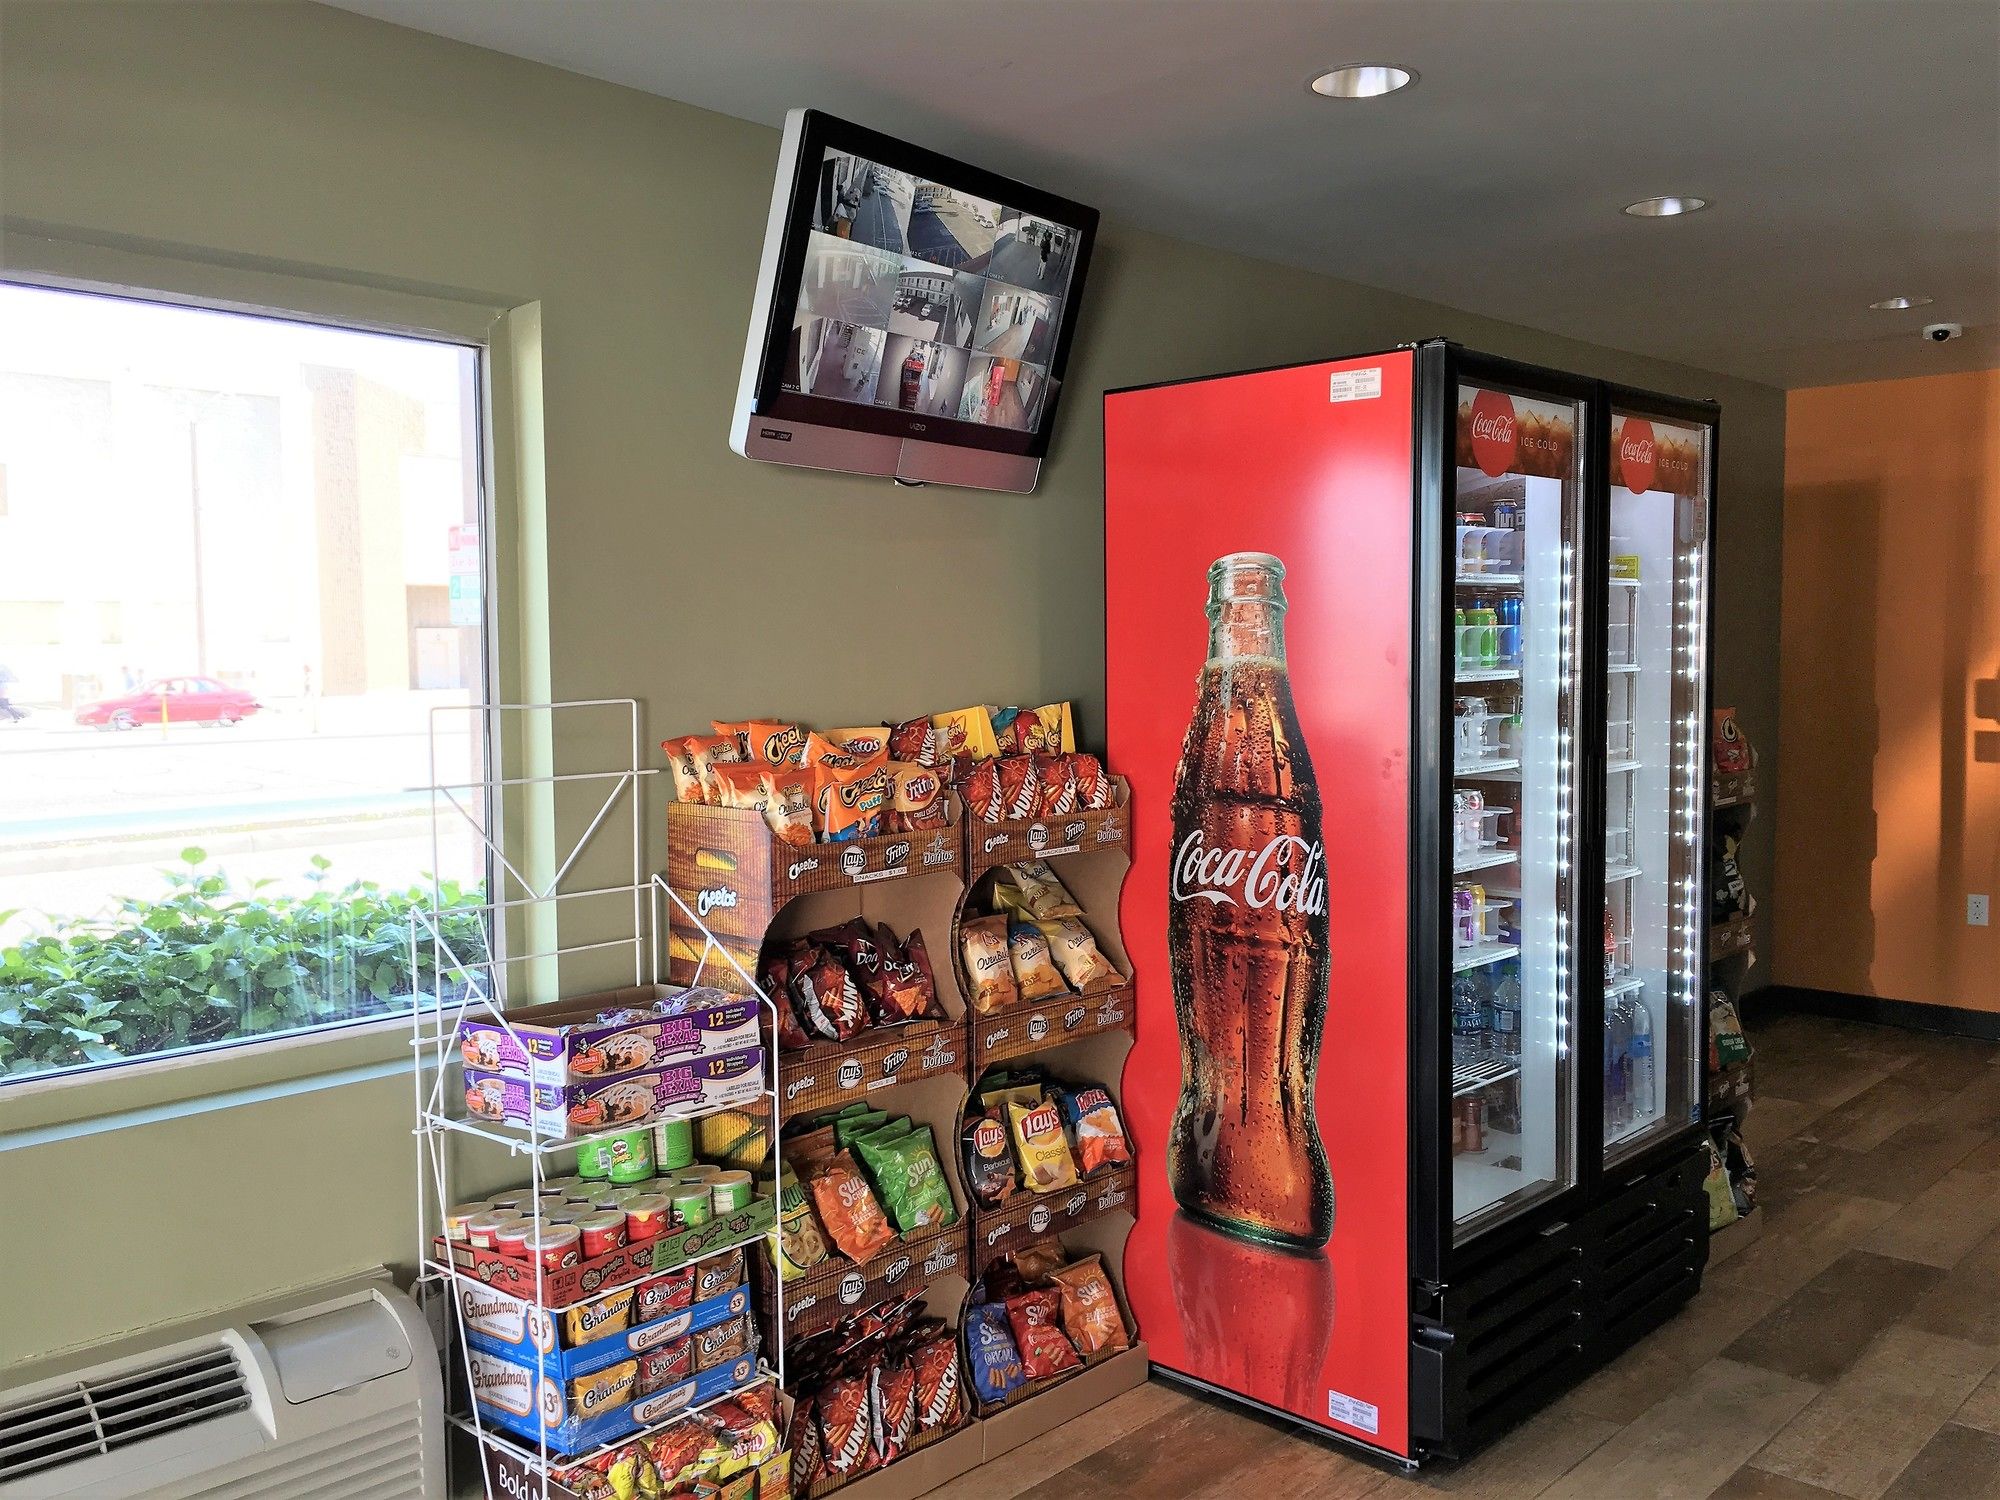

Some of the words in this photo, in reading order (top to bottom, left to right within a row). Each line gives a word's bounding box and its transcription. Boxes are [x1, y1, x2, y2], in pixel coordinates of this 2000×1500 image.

[1472, 411, 1514, 444] Coca-Cola
[1520, 436, 1534, 448] ICE
[1537, 438, 1558, 451] COLD
[1658, 458, 1670, 468] ICE
[1672, 459, 1688, 471] COLD
[905, 774, 935, 801] Fritos
[1065, 821, 1086, 841] Fritos
[1097, 828, 1122, 843] Doritos
[885, 841, 910, 864] Fritos
[923, 848, 955, 867] Doritos
[788, 856, 818, 880] Cheetos
[1173, 830, 1326, 916] Coca-Cola
[697, 885, 737, 917] Cheetos
[661, 1018, 693, 1036] BIG
[708, 1012, 724, 1028] 12
[1065, 1007, 1086, 1028] Fritos
[1097, 1010, 1124, 1027] Doritos
[654, 1029, 701, 1050] TEXAS
[708, 1060, 725, 1076] 12
[883, 1049, 908, 1073] Fritos
[922, 1050, 956, 1071] Doritos
[661, 1066, 693, 1084] BIG
[654, 1078, 702, 1099] TEXAS
[787, 1075, 815, 1100] Cheetos
[1025, 1109, 1060, 1139] Lay's
[1035, 1146, 1067, 1161] Classic
[1067, 1194, 1087, 1215] Fritos
[601, 1257, 624, 1281] Pringles
[885, 1257, 910, 1283] Fritos
[924, 1253, 957, 1275] Doritos
[499, 1463, 529, 1500] Bold
